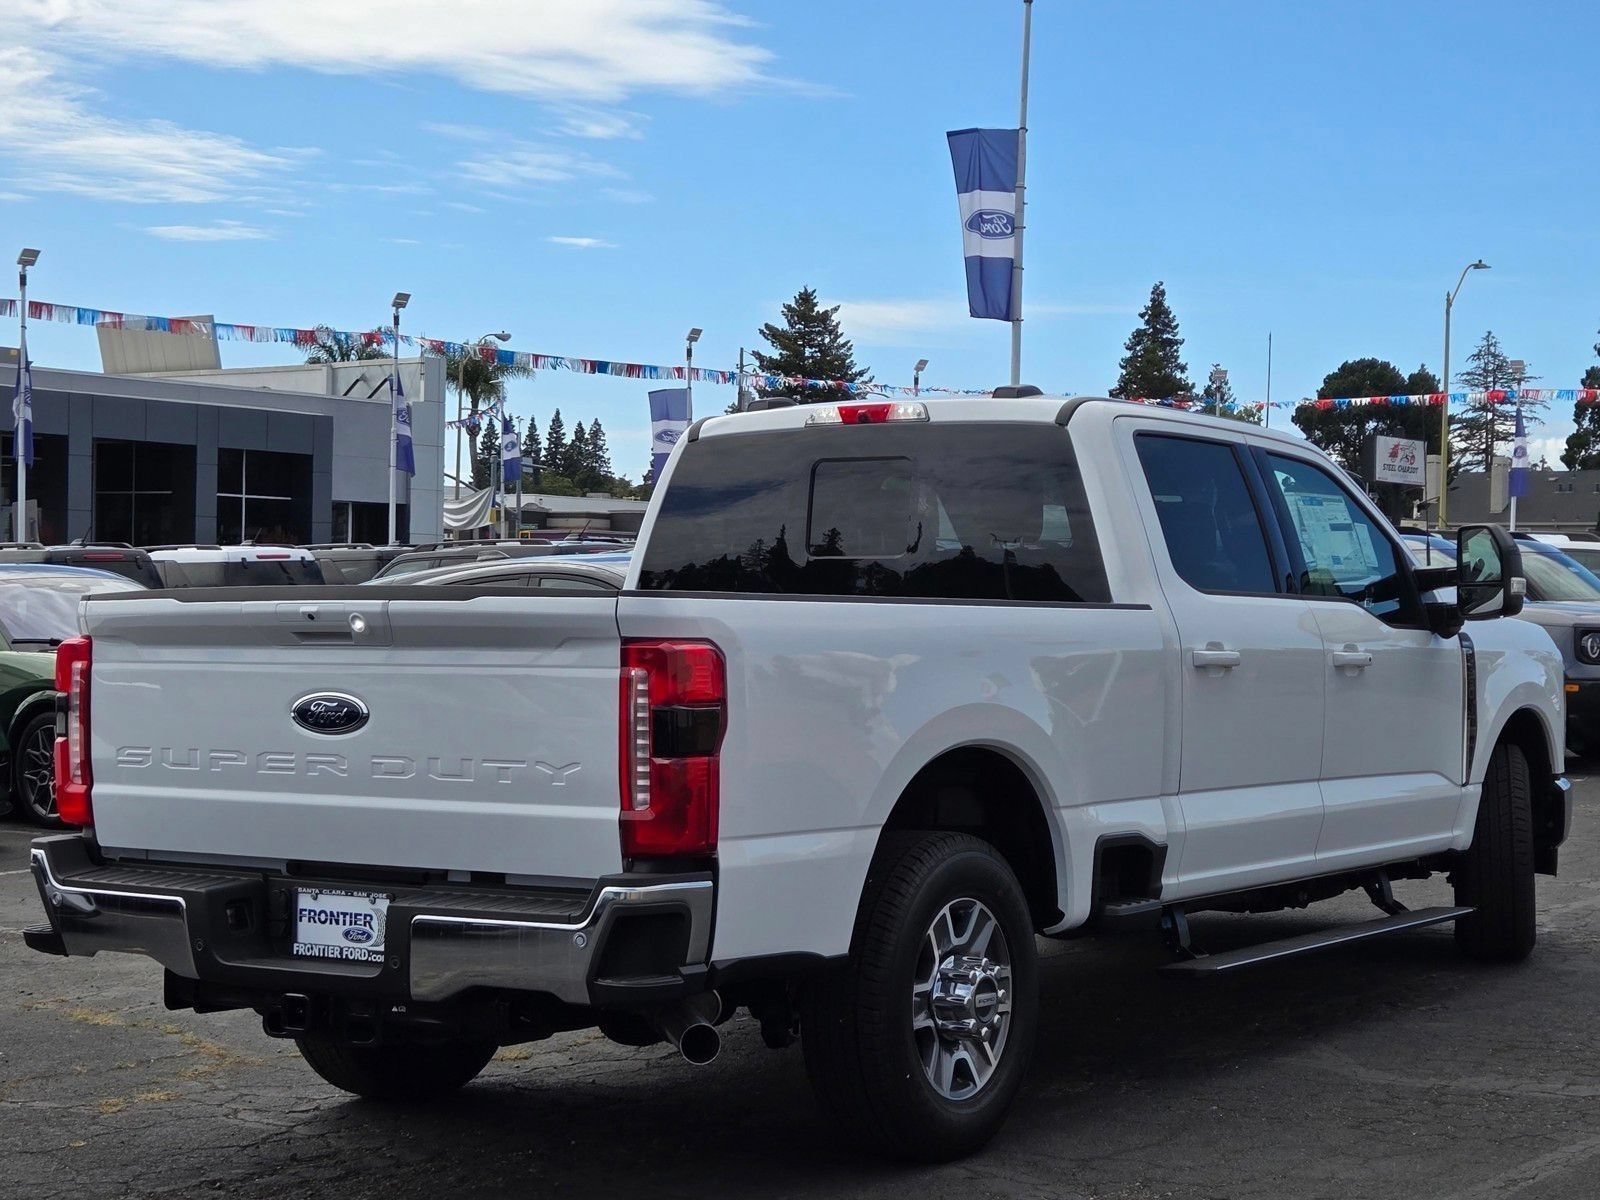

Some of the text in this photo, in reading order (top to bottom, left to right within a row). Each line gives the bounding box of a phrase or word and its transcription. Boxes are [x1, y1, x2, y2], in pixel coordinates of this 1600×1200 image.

[1382, 463, 1397, 472] STEEL
[308, 700, 348, 724] Ford
[115, 745, 582, 786] SUPER DUTY
[298, 908, 375, 932] FRONTIER
[349, 929, 368, 941] Ford
[293, 943, 385, 962] FRONTIER FORD.co
